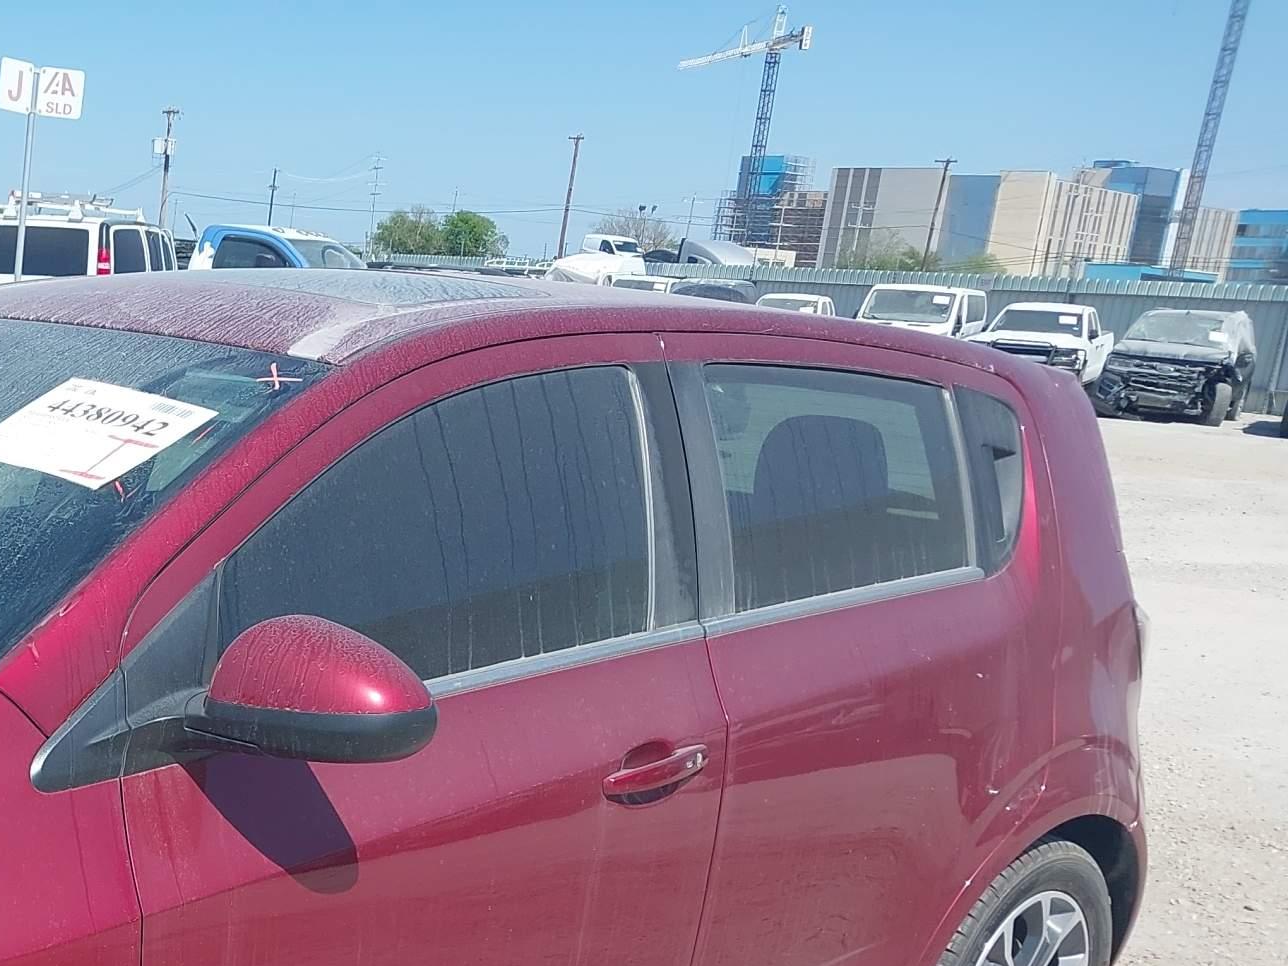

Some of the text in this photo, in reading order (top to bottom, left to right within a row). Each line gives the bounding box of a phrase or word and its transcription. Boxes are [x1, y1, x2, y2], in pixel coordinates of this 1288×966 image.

[7, 70, 23, 102] J
[45, 101, 73, 116] SLD
[47, 399, 169, 436] 44380942
